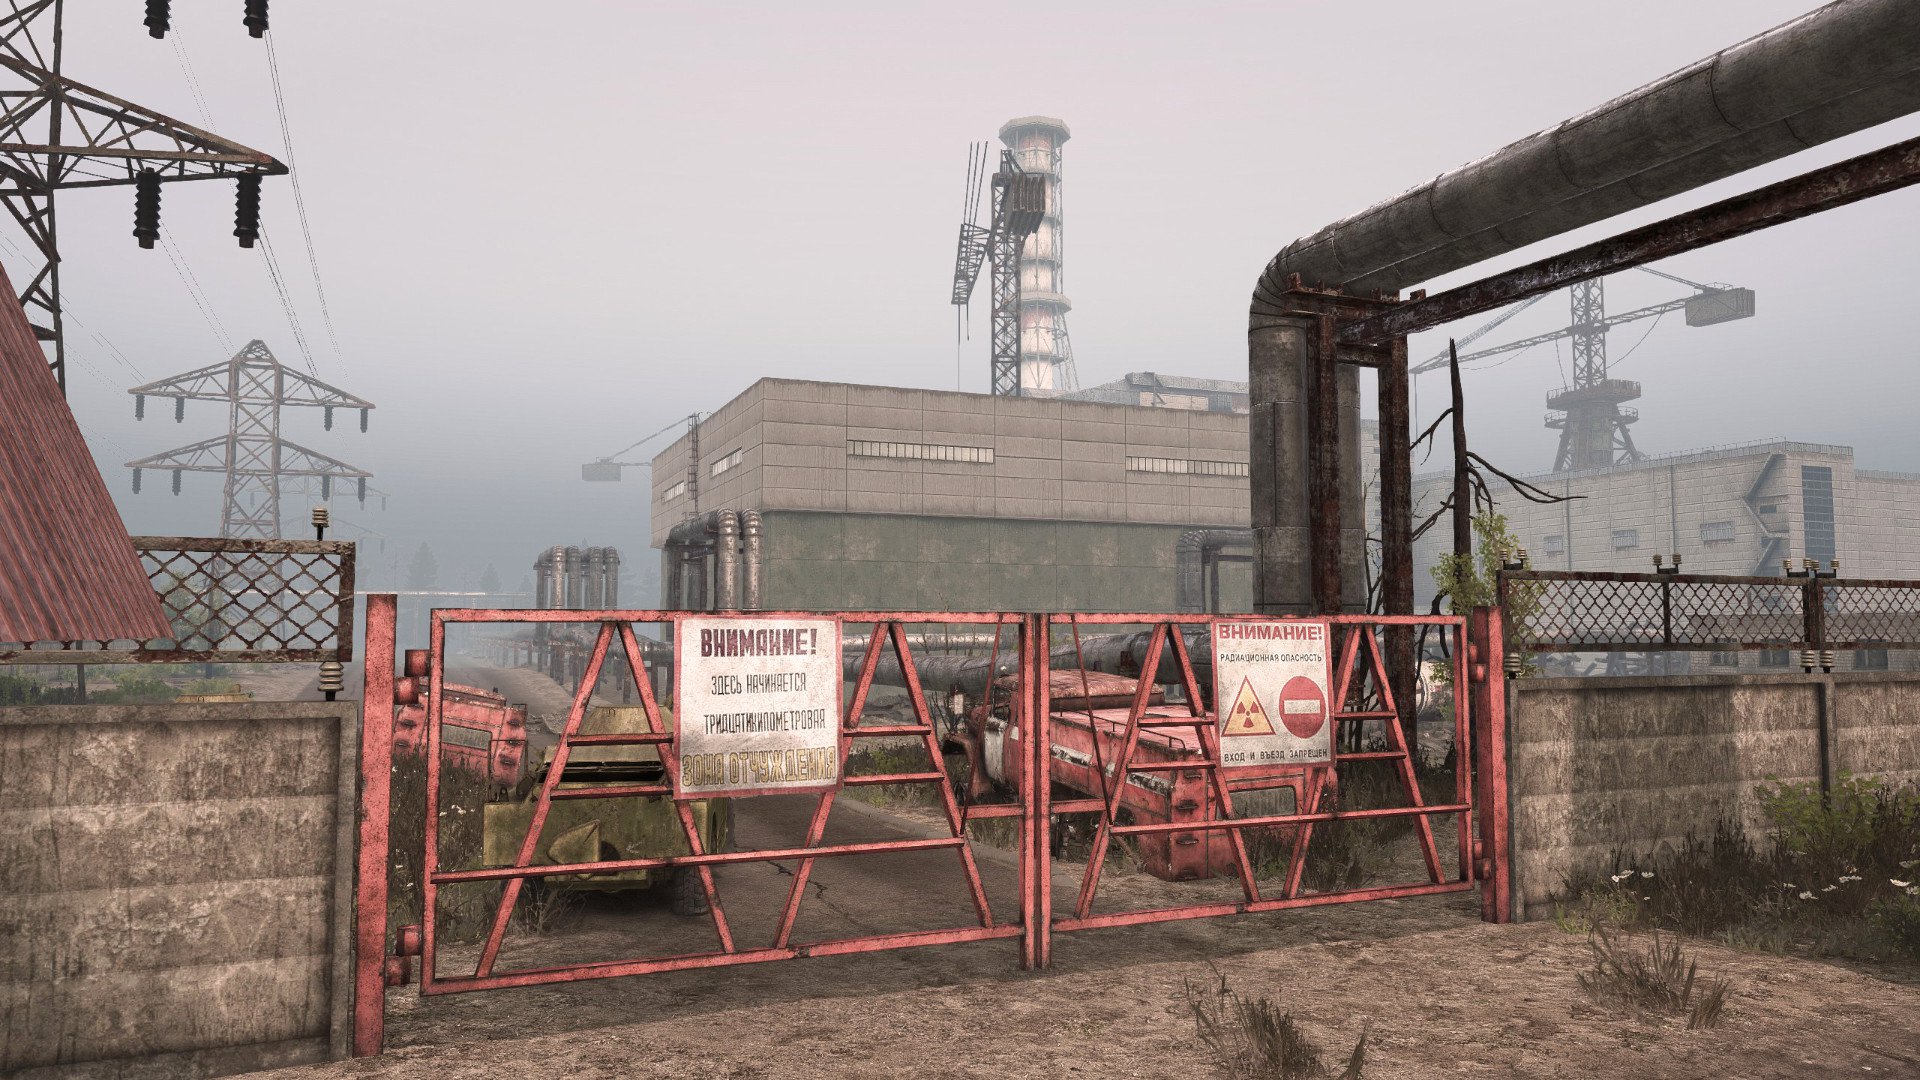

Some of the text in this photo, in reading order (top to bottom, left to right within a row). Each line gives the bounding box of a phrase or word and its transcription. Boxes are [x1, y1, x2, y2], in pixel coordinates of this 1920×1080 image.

[700, 628, 818, 658] ВНИМАНИЕ!
[1218, 624, 1323, 641] ВНИМАНИЕ!
[1220, 653, 1322, 663] РАДИАЦИОННАЯ ОПАСНОСТЬ
[711, 672, 807, 696] ЗДЕСЬ НАЧИНАЕТСЯ
[704, 708, 826, 735] ТРИДЦАТИКИЛОМЕТРОВАЯ
[681, 746, 836, 787] ЗОНА ОТЧУЖДЕНИЯ
[1224, 748, 1328, 762] ВХОД И ВЪЕЗД ЗАПРЕЩЕН
